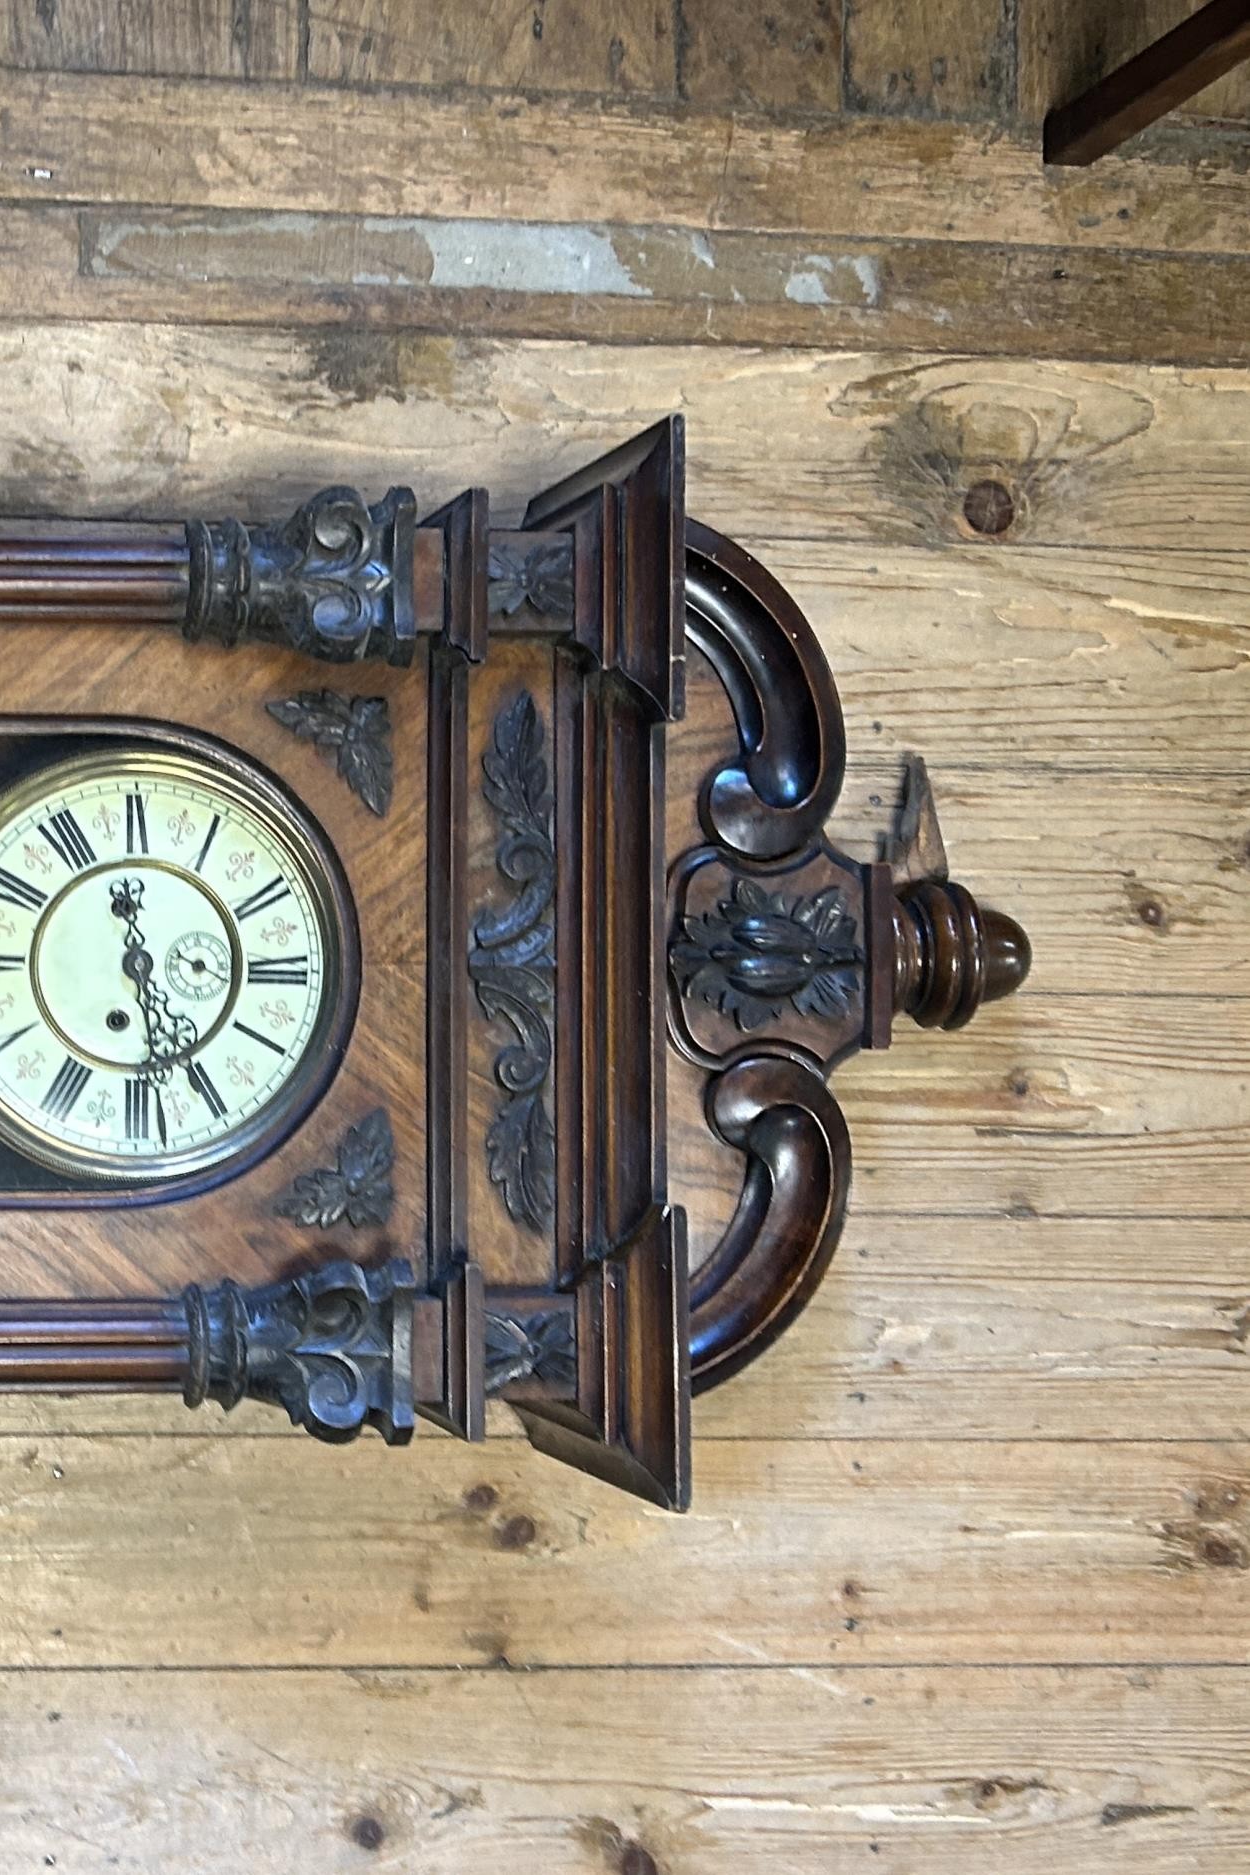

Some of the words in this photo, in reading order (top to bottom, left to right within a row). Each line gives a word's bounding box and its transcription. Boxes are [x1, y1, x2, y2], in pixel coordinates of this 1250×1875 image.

[39, 810, 97, 869] VIII
[126, 794, 148, 853] IX
[234, 875, 291, 920] XI
[248, 954, 307, 984] XII
[233, 1021, 285, 1055] I
[125, 1079, 148, 1139] III
